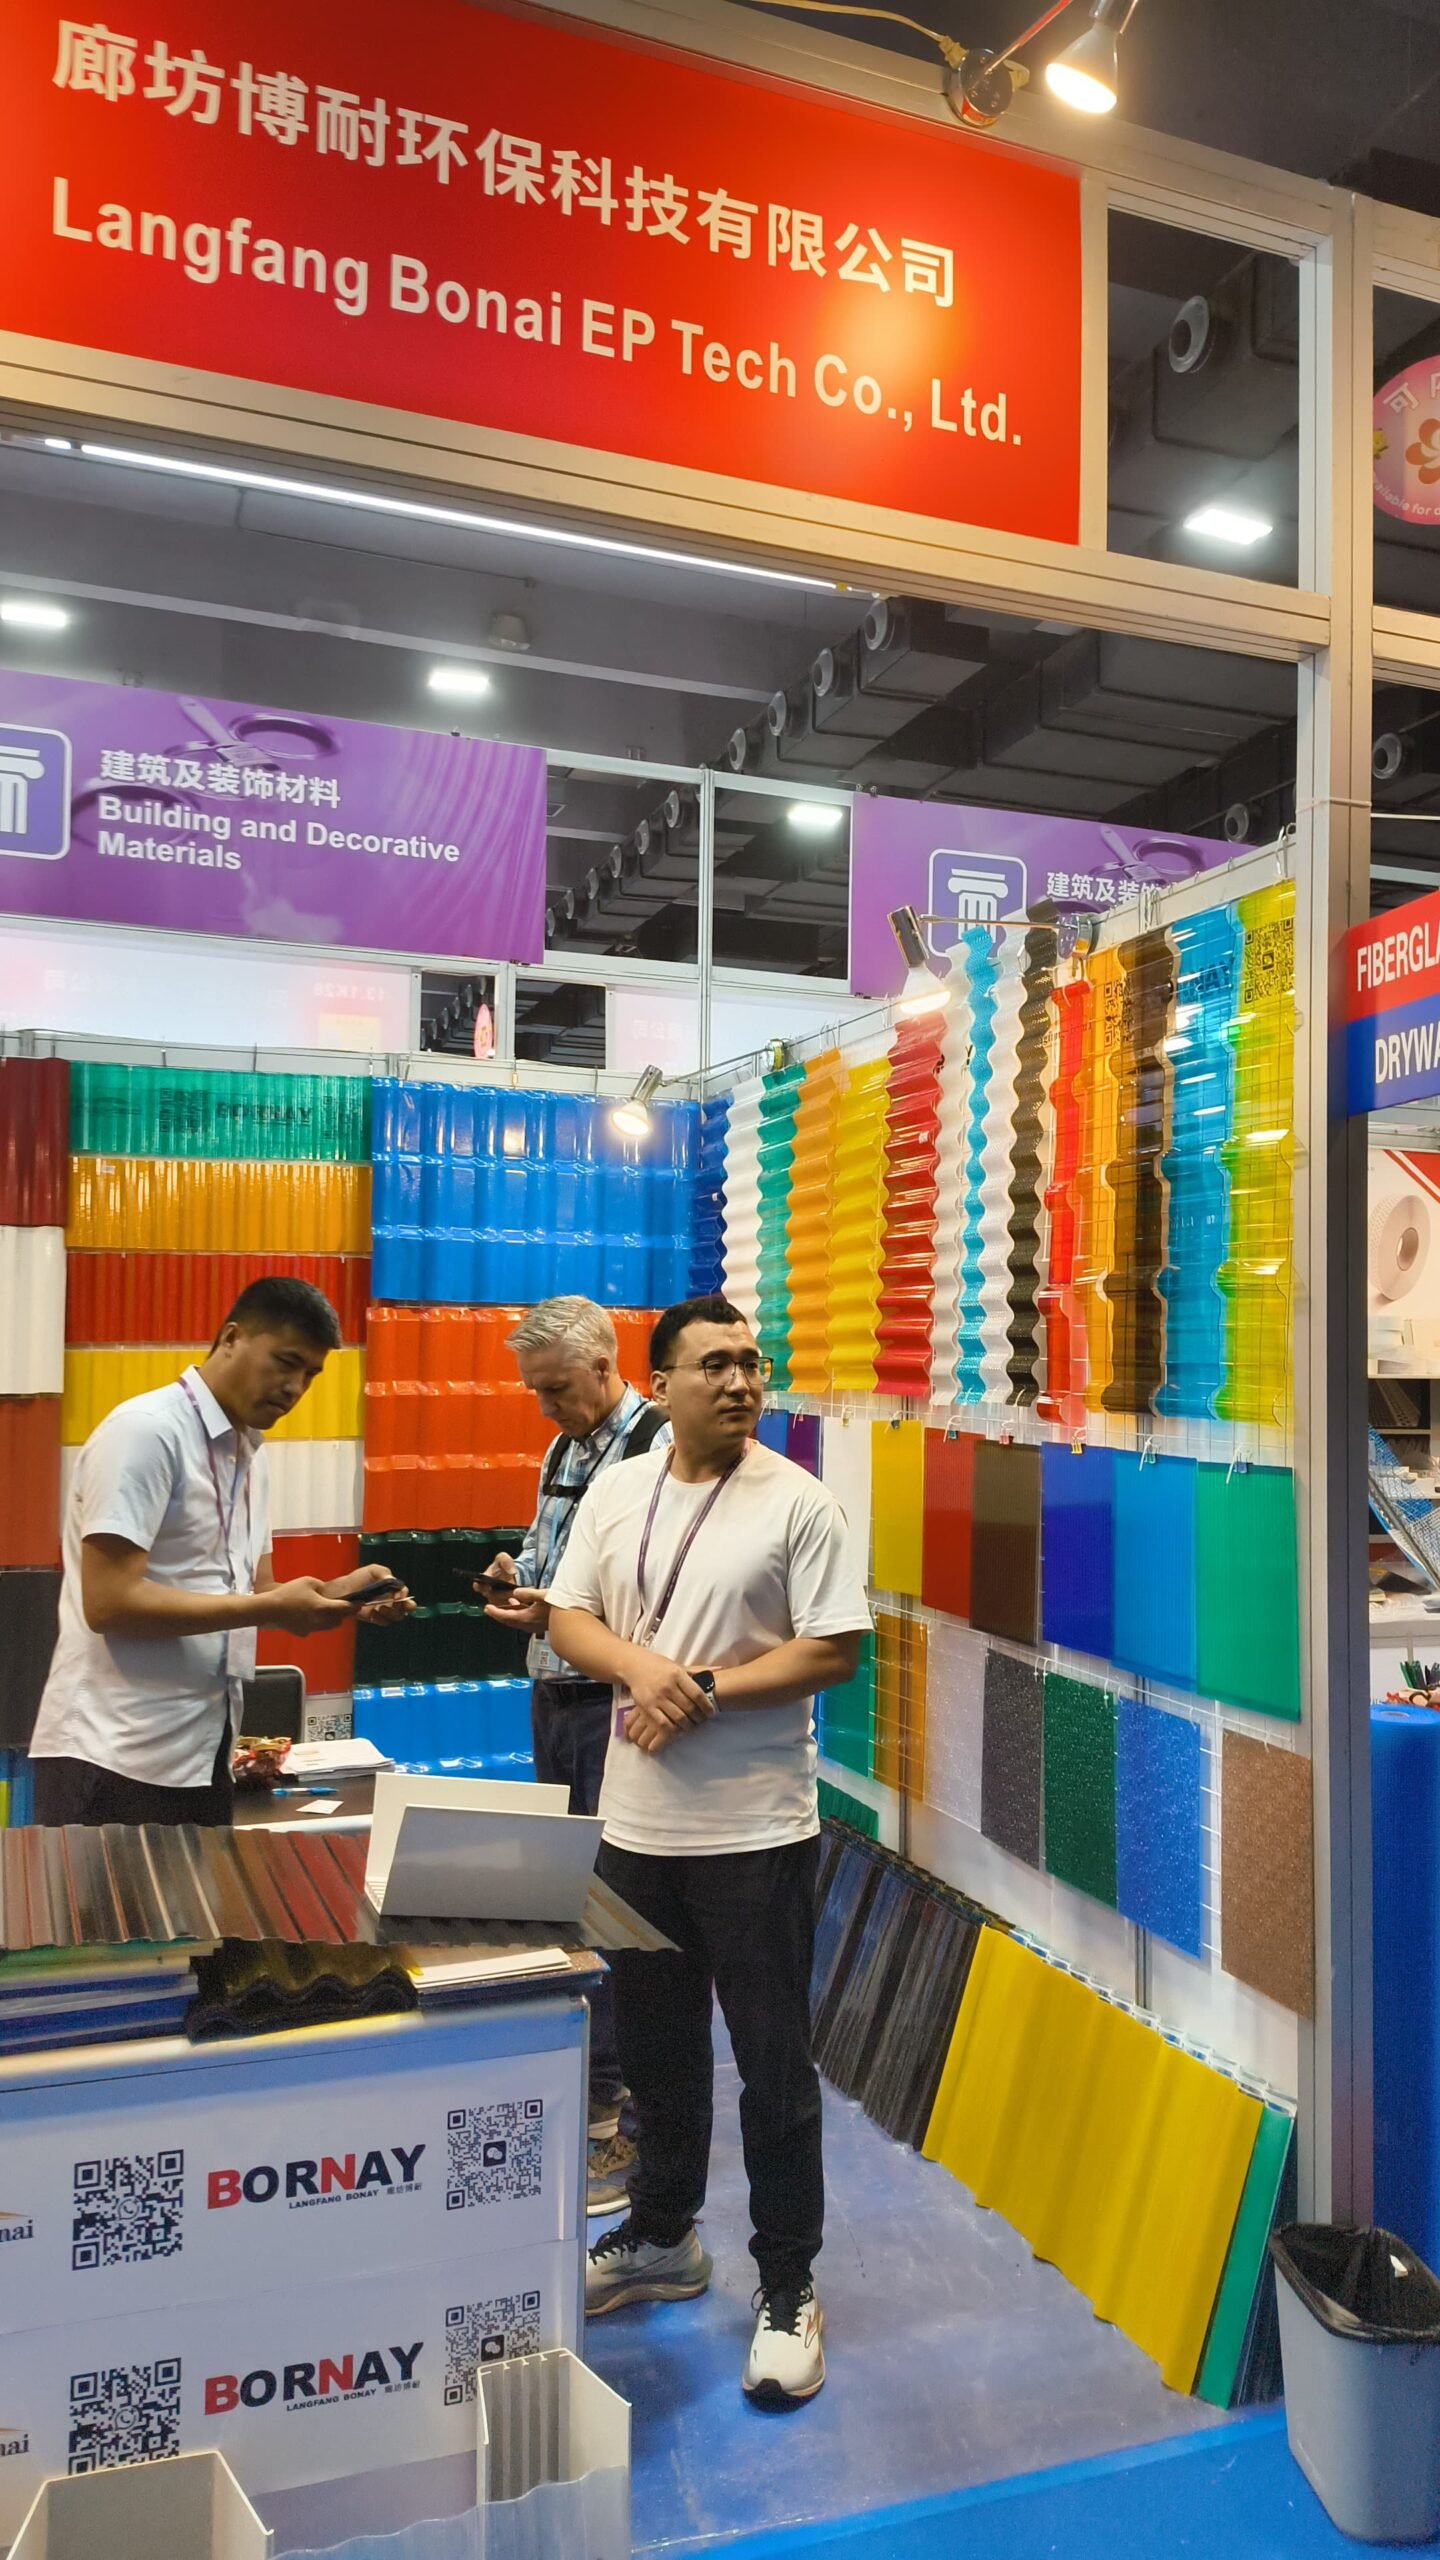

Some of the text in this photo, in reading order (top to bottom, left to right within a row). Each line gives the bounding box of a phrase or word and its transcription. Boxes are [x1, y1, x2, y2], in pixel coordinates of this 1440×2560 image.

[52, 19, 957, 308] 廊坊博耐环保科技有限公司
[52, 176, 1022, 447] Langfang Bonai EP Tech Co., Ltd.
[100, 749, 342, 809] 建筑及装饰材料
[97, 830, 242, 871] Materials
[98, 795, 461, 863] Building and Decorative
[207, 2144, 426, 2210] BORNAY
[288, 2194, 342, 2210] LANGFANG
[345, 2188, 380, 2201] BONAY
[204, 2341, 425, 2416] BORNAY
[286, 2395, 340, 2412] LANGFANG
[343, 2388, 377, 2402] BONAY
